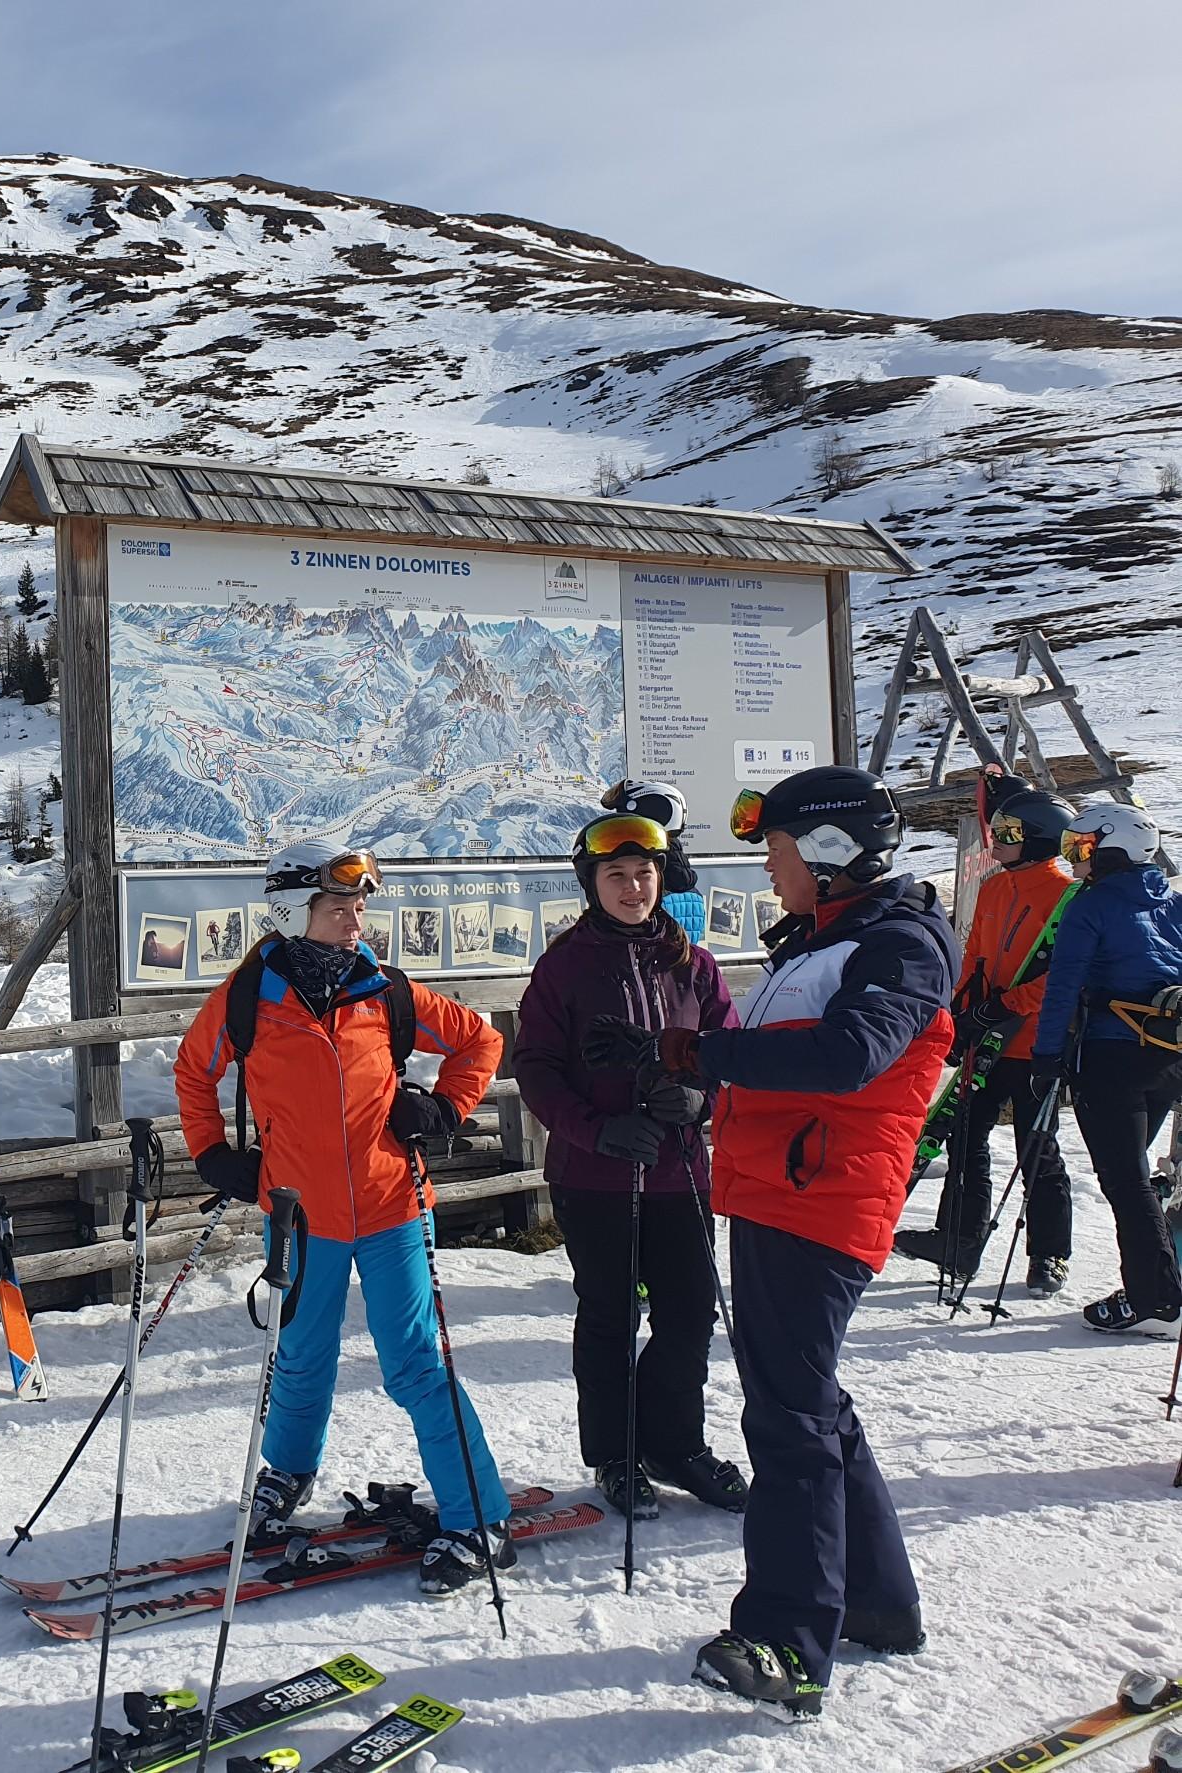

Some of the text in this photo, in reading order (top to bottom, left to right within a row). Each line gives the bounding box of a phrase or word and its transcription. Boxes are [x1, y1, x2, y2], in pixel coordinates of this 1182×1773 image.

[122, 540, 158, 548] DOLOMITI
[122, 548, 158, 556] SUPERSKI
[290, 551, 471, 576] 3 ZINNEN DOLOMITES
[548, 580, 584, 590] 3 ZINNEN
[634, 574, 680, 584] ANLAGEN
[688, 576, 730, 588] IMPIANTI
[738, 579, 762, 590] LIFTS
[758, 751, 767, 760] 31
[795, 751, 810, 760] 115
[799, 800, 866, 812] slokker
[372, 884, 405, 898] ARE
[410, 883, 450, 897] YOUR
[454, 882, 520, 896] MOMENTS
[282, 1237, 291, 1272] ATOMIC
[132, 1254, 145, 1324] ATOMIC
[258, 1351, 276, 1424] ATOMIC
[336, 1658, 376, 1684] 160
[264, 1673, 326, 1706] REBELS
[279, 1682, 342, 1712] WORLDCUP
[407, 1700, 454, 1722] 160
[350, 1717, 412, 1757] REBELS
[370, 1724, 426, 1763] WORLDCUP
